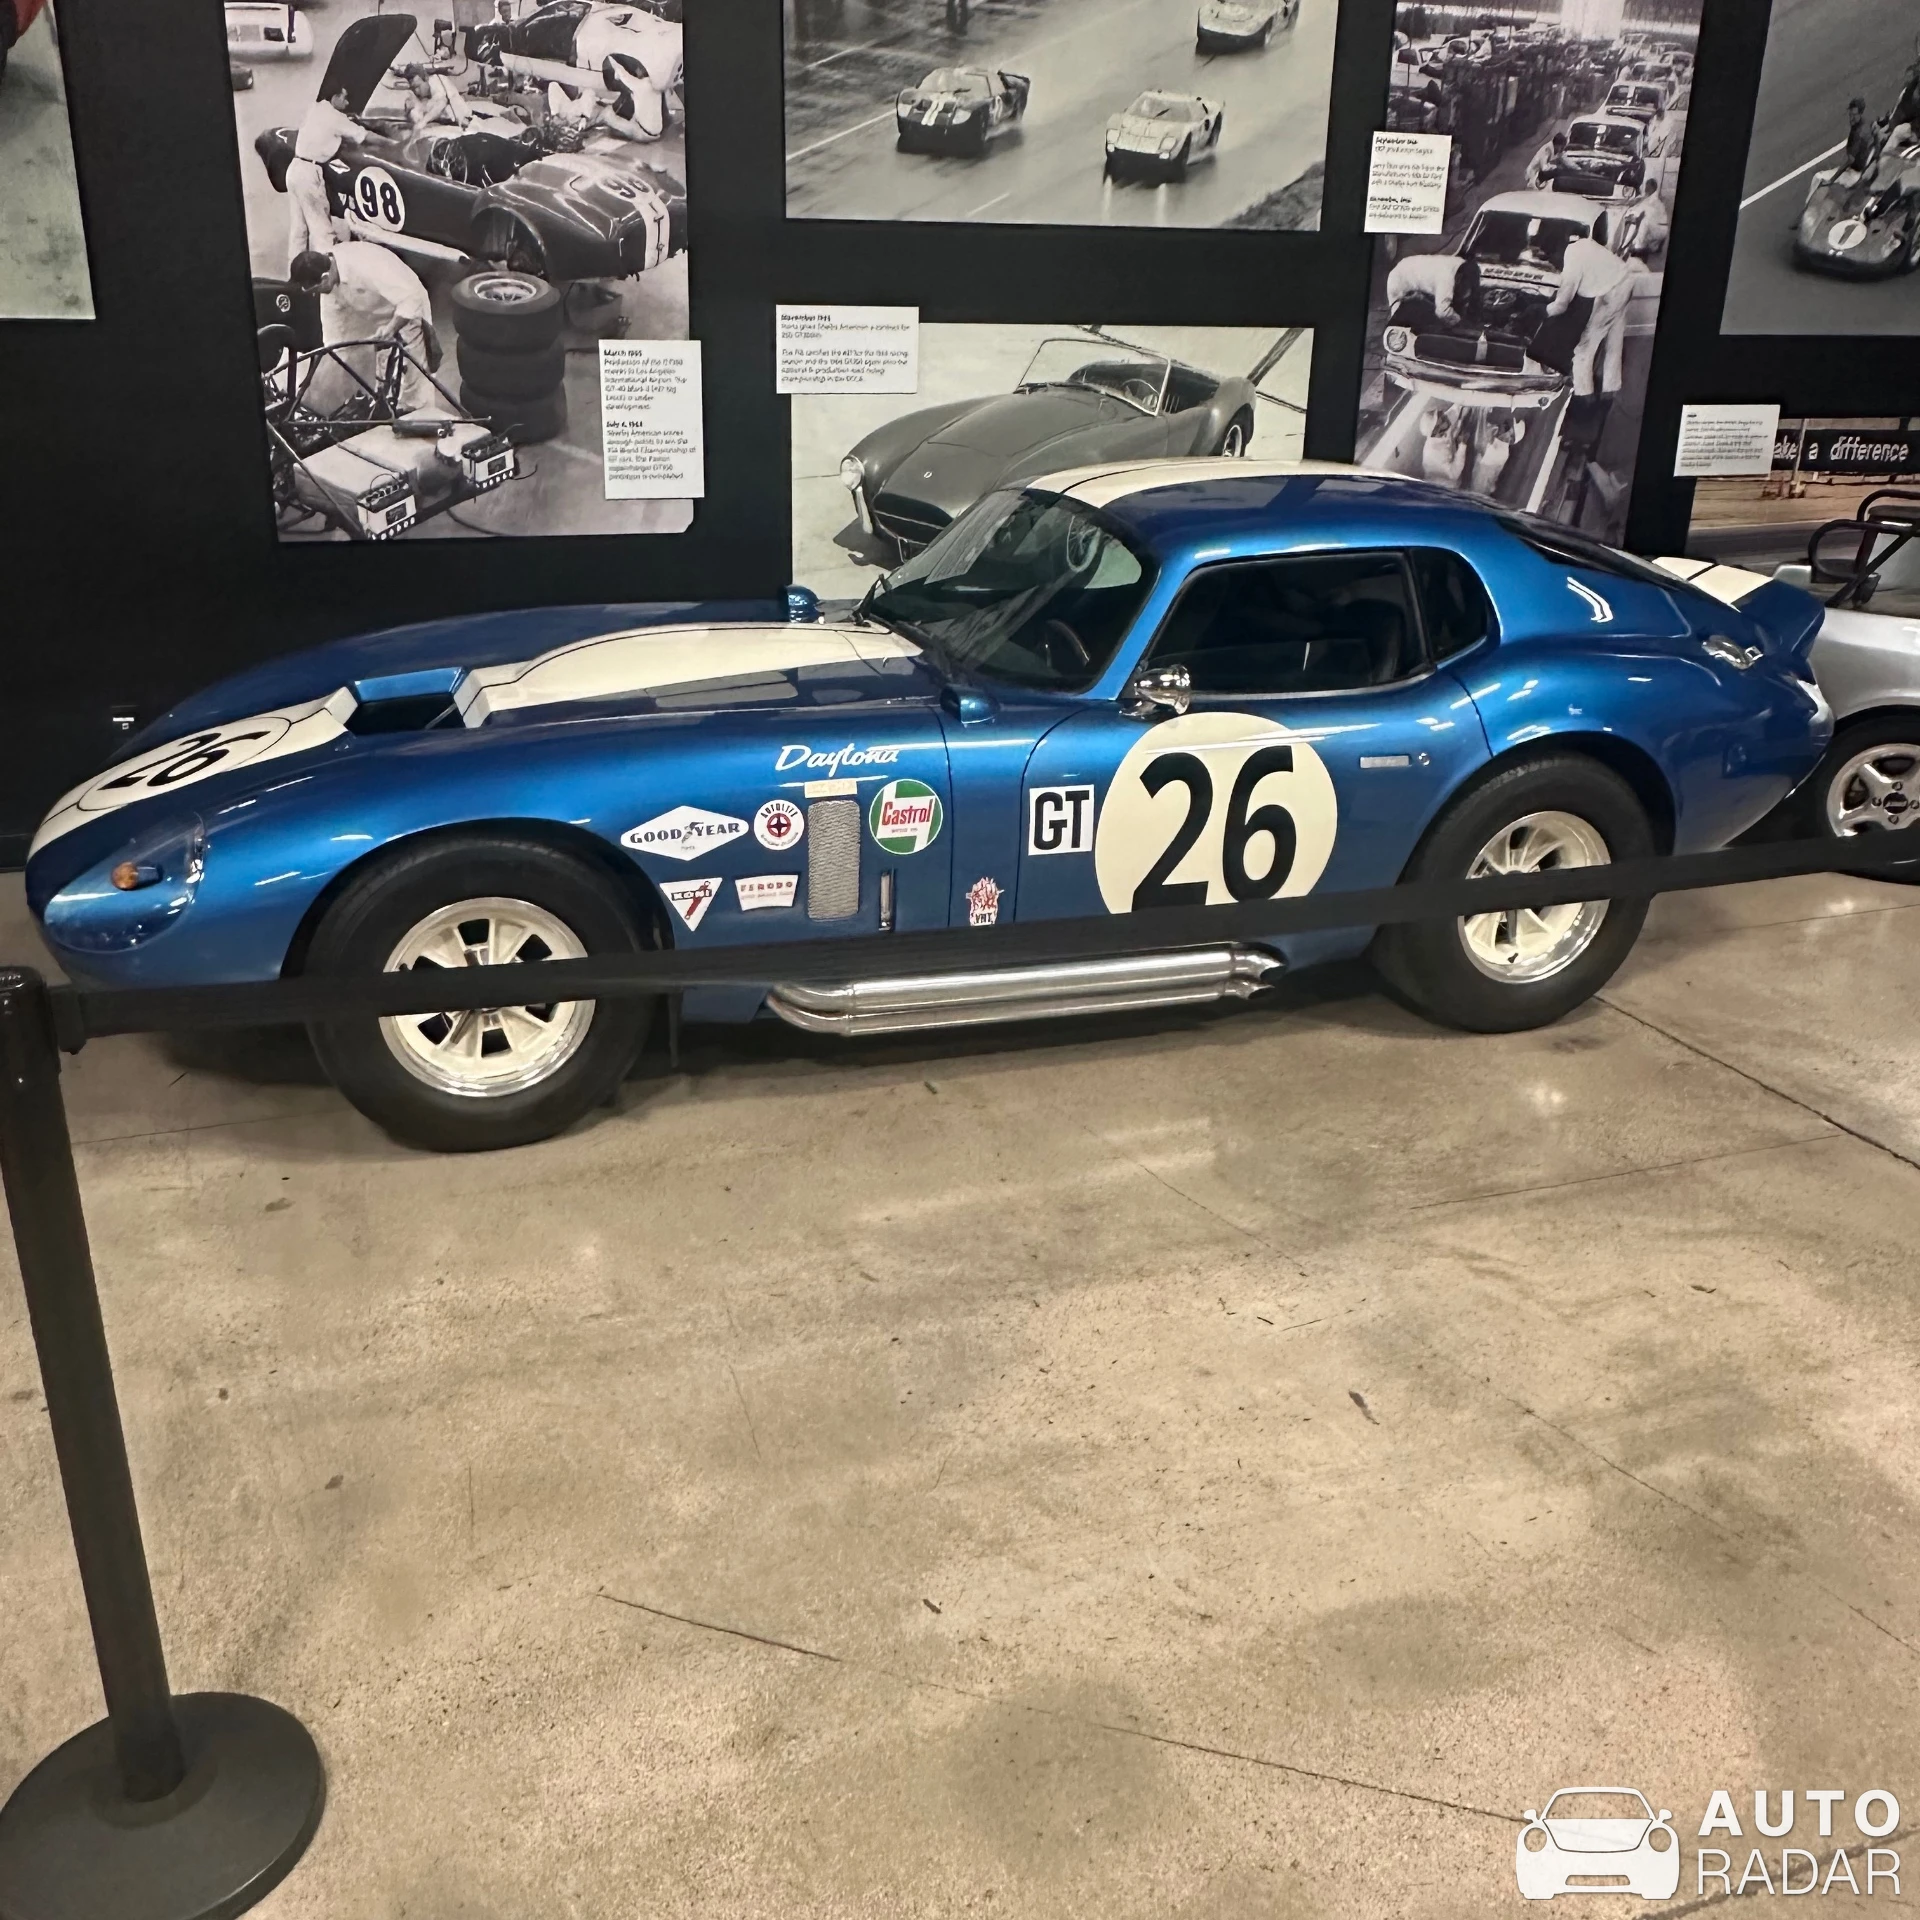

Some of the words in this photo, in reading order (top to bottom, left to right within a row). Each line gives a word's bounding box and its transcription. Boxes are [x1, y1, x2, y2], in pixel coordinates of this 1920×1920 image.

[360, 176, 402, 225] 98
[1837, 224, 1859, 245] 1
[1773, 435, 1799, 460] ake
[1808, 442, 1819, 460] a
[1830, 436, 1909, 462] difference
[97, 731, 271, 790] 26
[775, 743, 899, 777] Daytona
[882, 799, 933, 826] Castrol
[1033, 790, 1090, 851] GT
[1132, 745, 1297, 912] 26
[740, 882, 793, 893] FERODO
